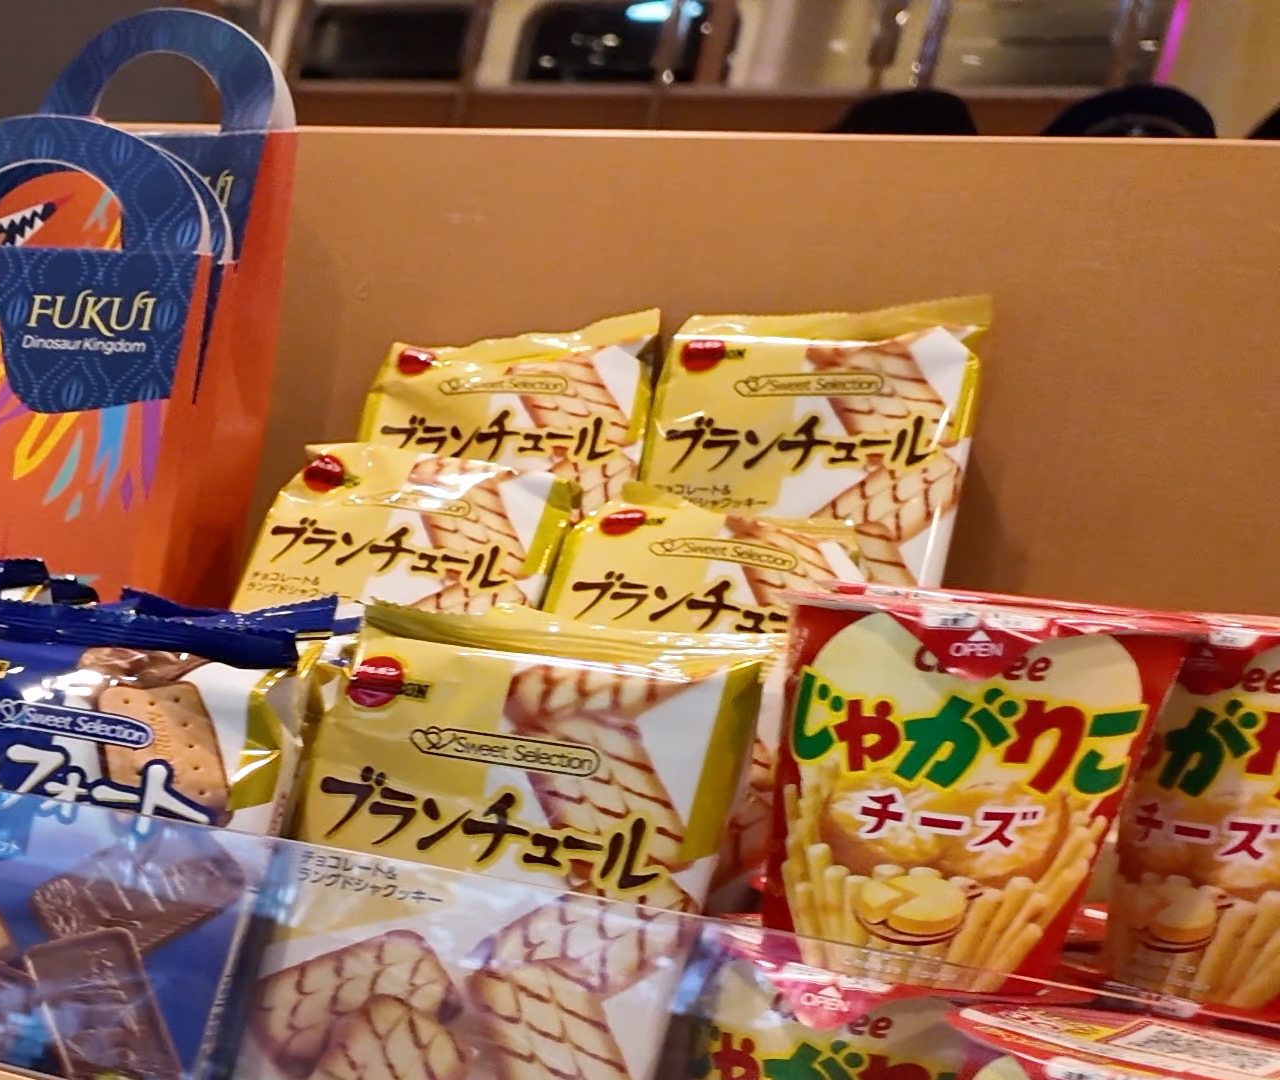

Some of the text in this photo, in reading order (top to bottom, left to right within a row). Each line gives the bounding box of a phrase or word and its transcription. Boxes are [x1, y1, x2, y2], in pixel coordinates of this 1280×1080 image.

[25, 292, 157, 334] FUKUI
[22, 334, 146, 355] Dinosaur Kingdom
[817, 376, 882, 394] Selection
[665, 416, 940, 472] ブランチュール
[271, 517, 509, 590] ブランチュール
[572, 570, 789, 634] ブランチュ
[950, 640, 1004, 659] OPEN
[77, 716, 149, 745] Selection
[453, 733, 593, 772] Sweet Selection
[793, 668, 1145, 794] じゃがりこ
[321, 765, 663, 893] ブランチュール
[860, 794, 1040, 848] チーズ
